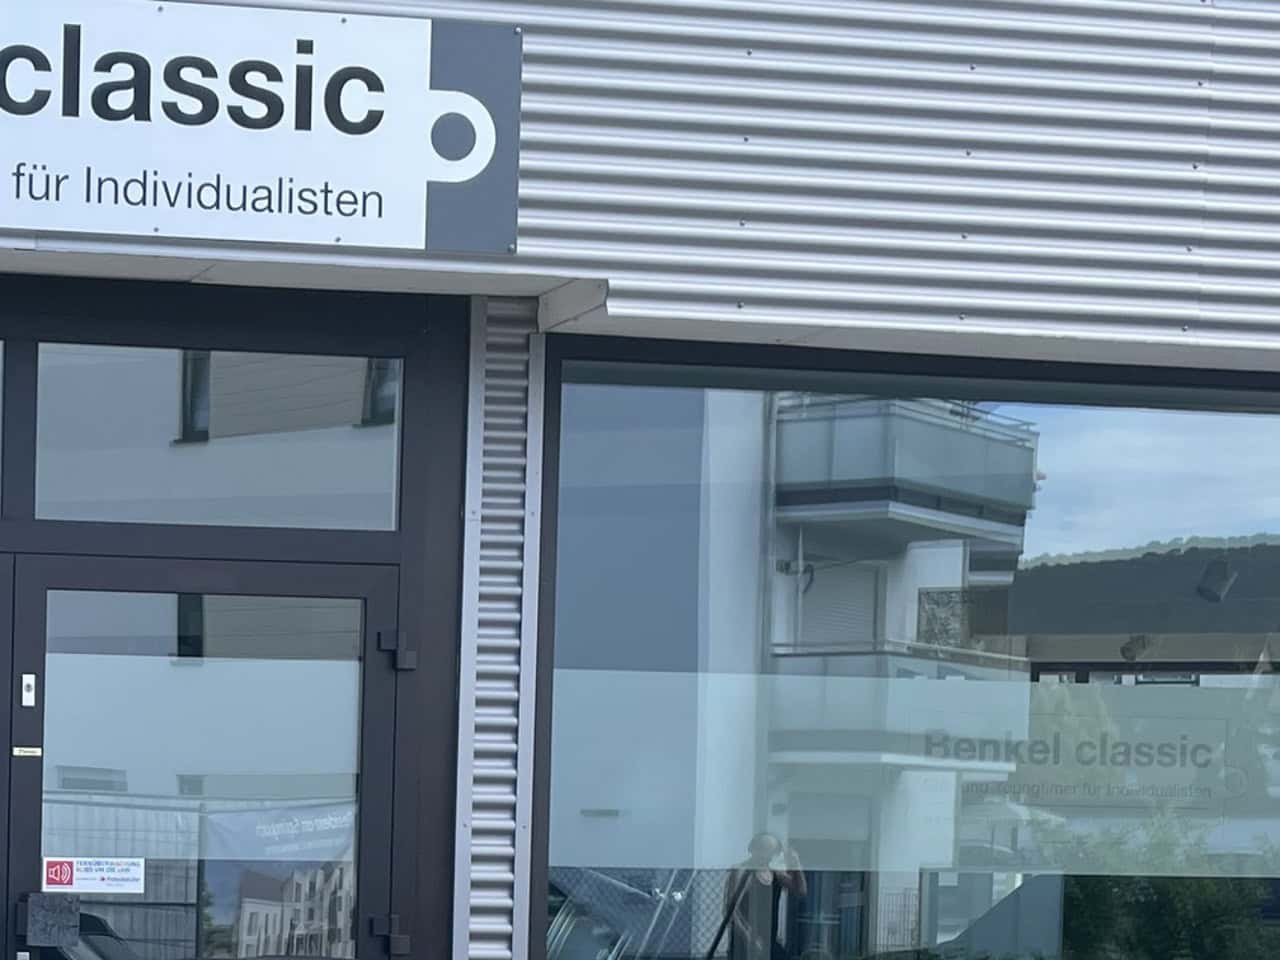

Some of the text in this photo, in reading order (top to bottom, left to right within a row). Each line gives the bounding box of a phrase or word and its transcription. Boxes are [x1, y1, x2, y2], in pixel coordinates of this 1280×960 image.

[12, 162, 69, 203] für
[84, 165, 385, 219] Individualisten
[924, 728, 1214, 770] Benkel classic
